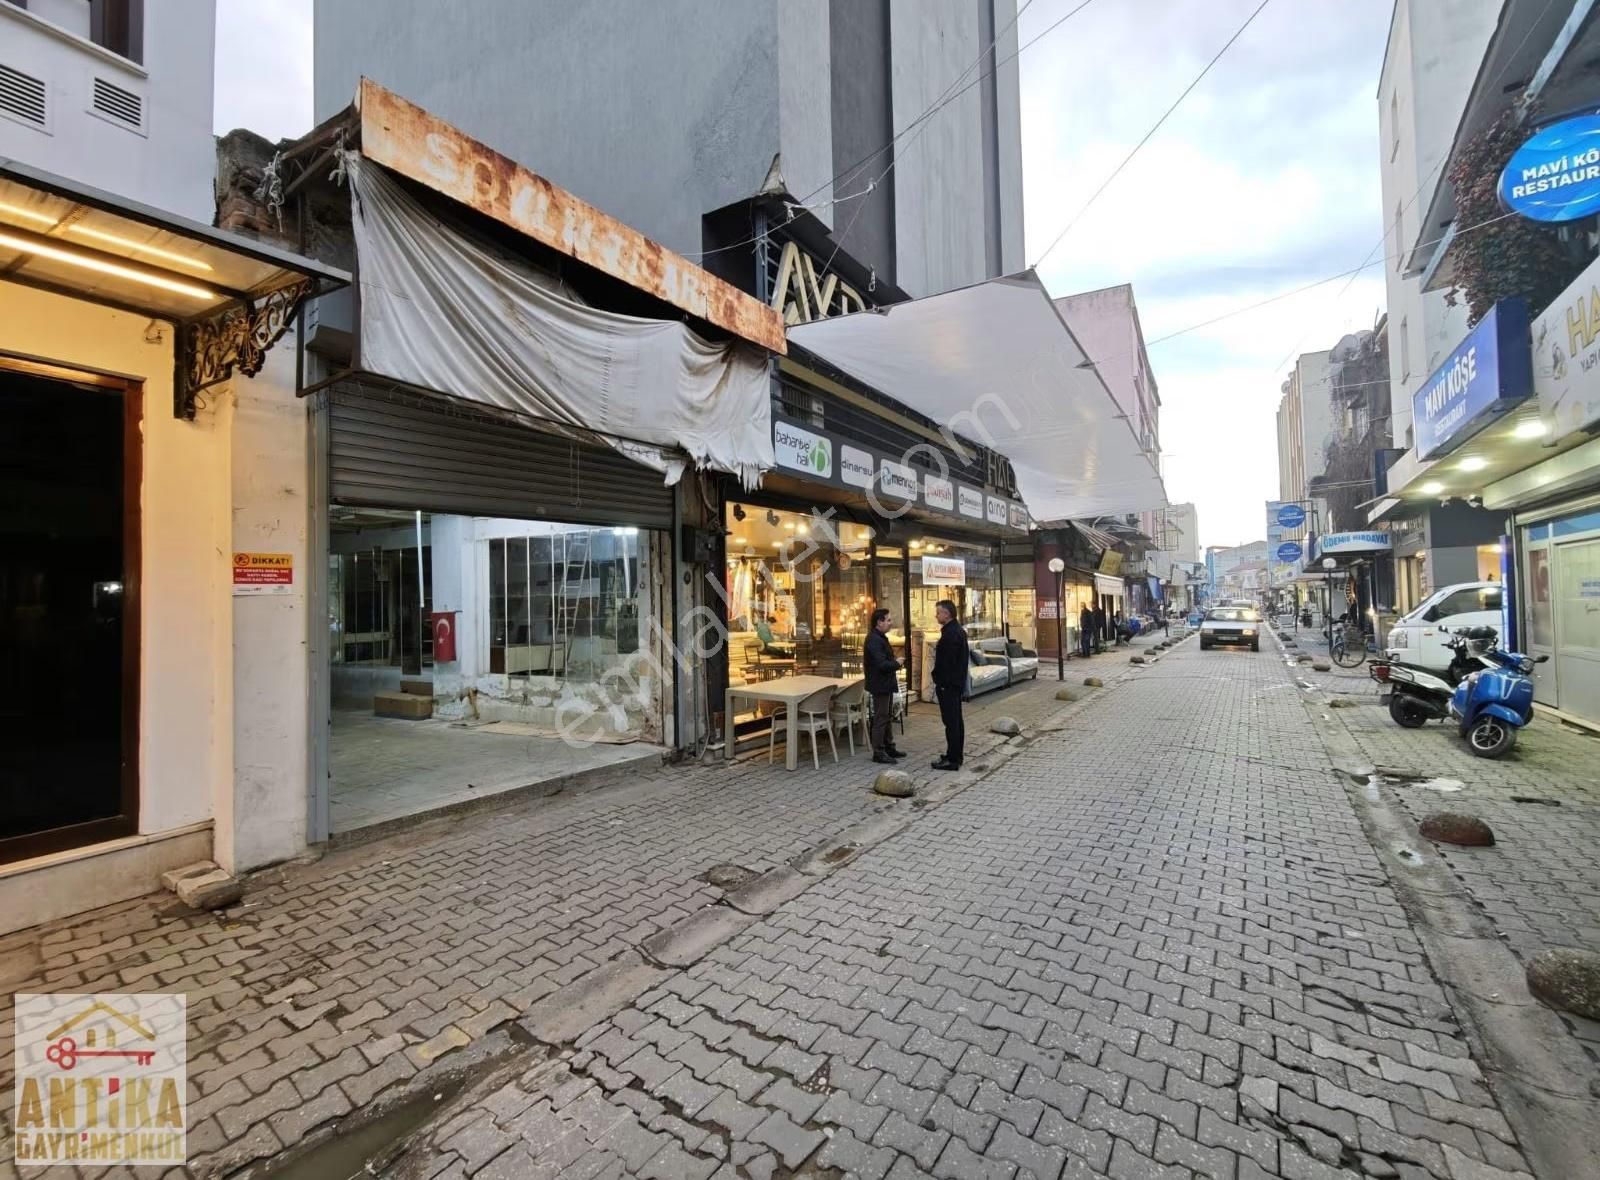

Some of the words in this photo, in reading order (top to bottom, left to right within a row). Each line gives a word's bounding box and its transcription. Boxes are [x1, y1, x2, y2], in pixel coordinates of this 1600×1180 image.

[1512, 165, 1600, 199] RESTAUR
[1522, 156, 1568, 181] MAVİ
[1425, 370, 1446, 421] MAVİ
[1447, 346, 1477, 400] KÖŞE
[841, 457, 873, 477] dinarsu
